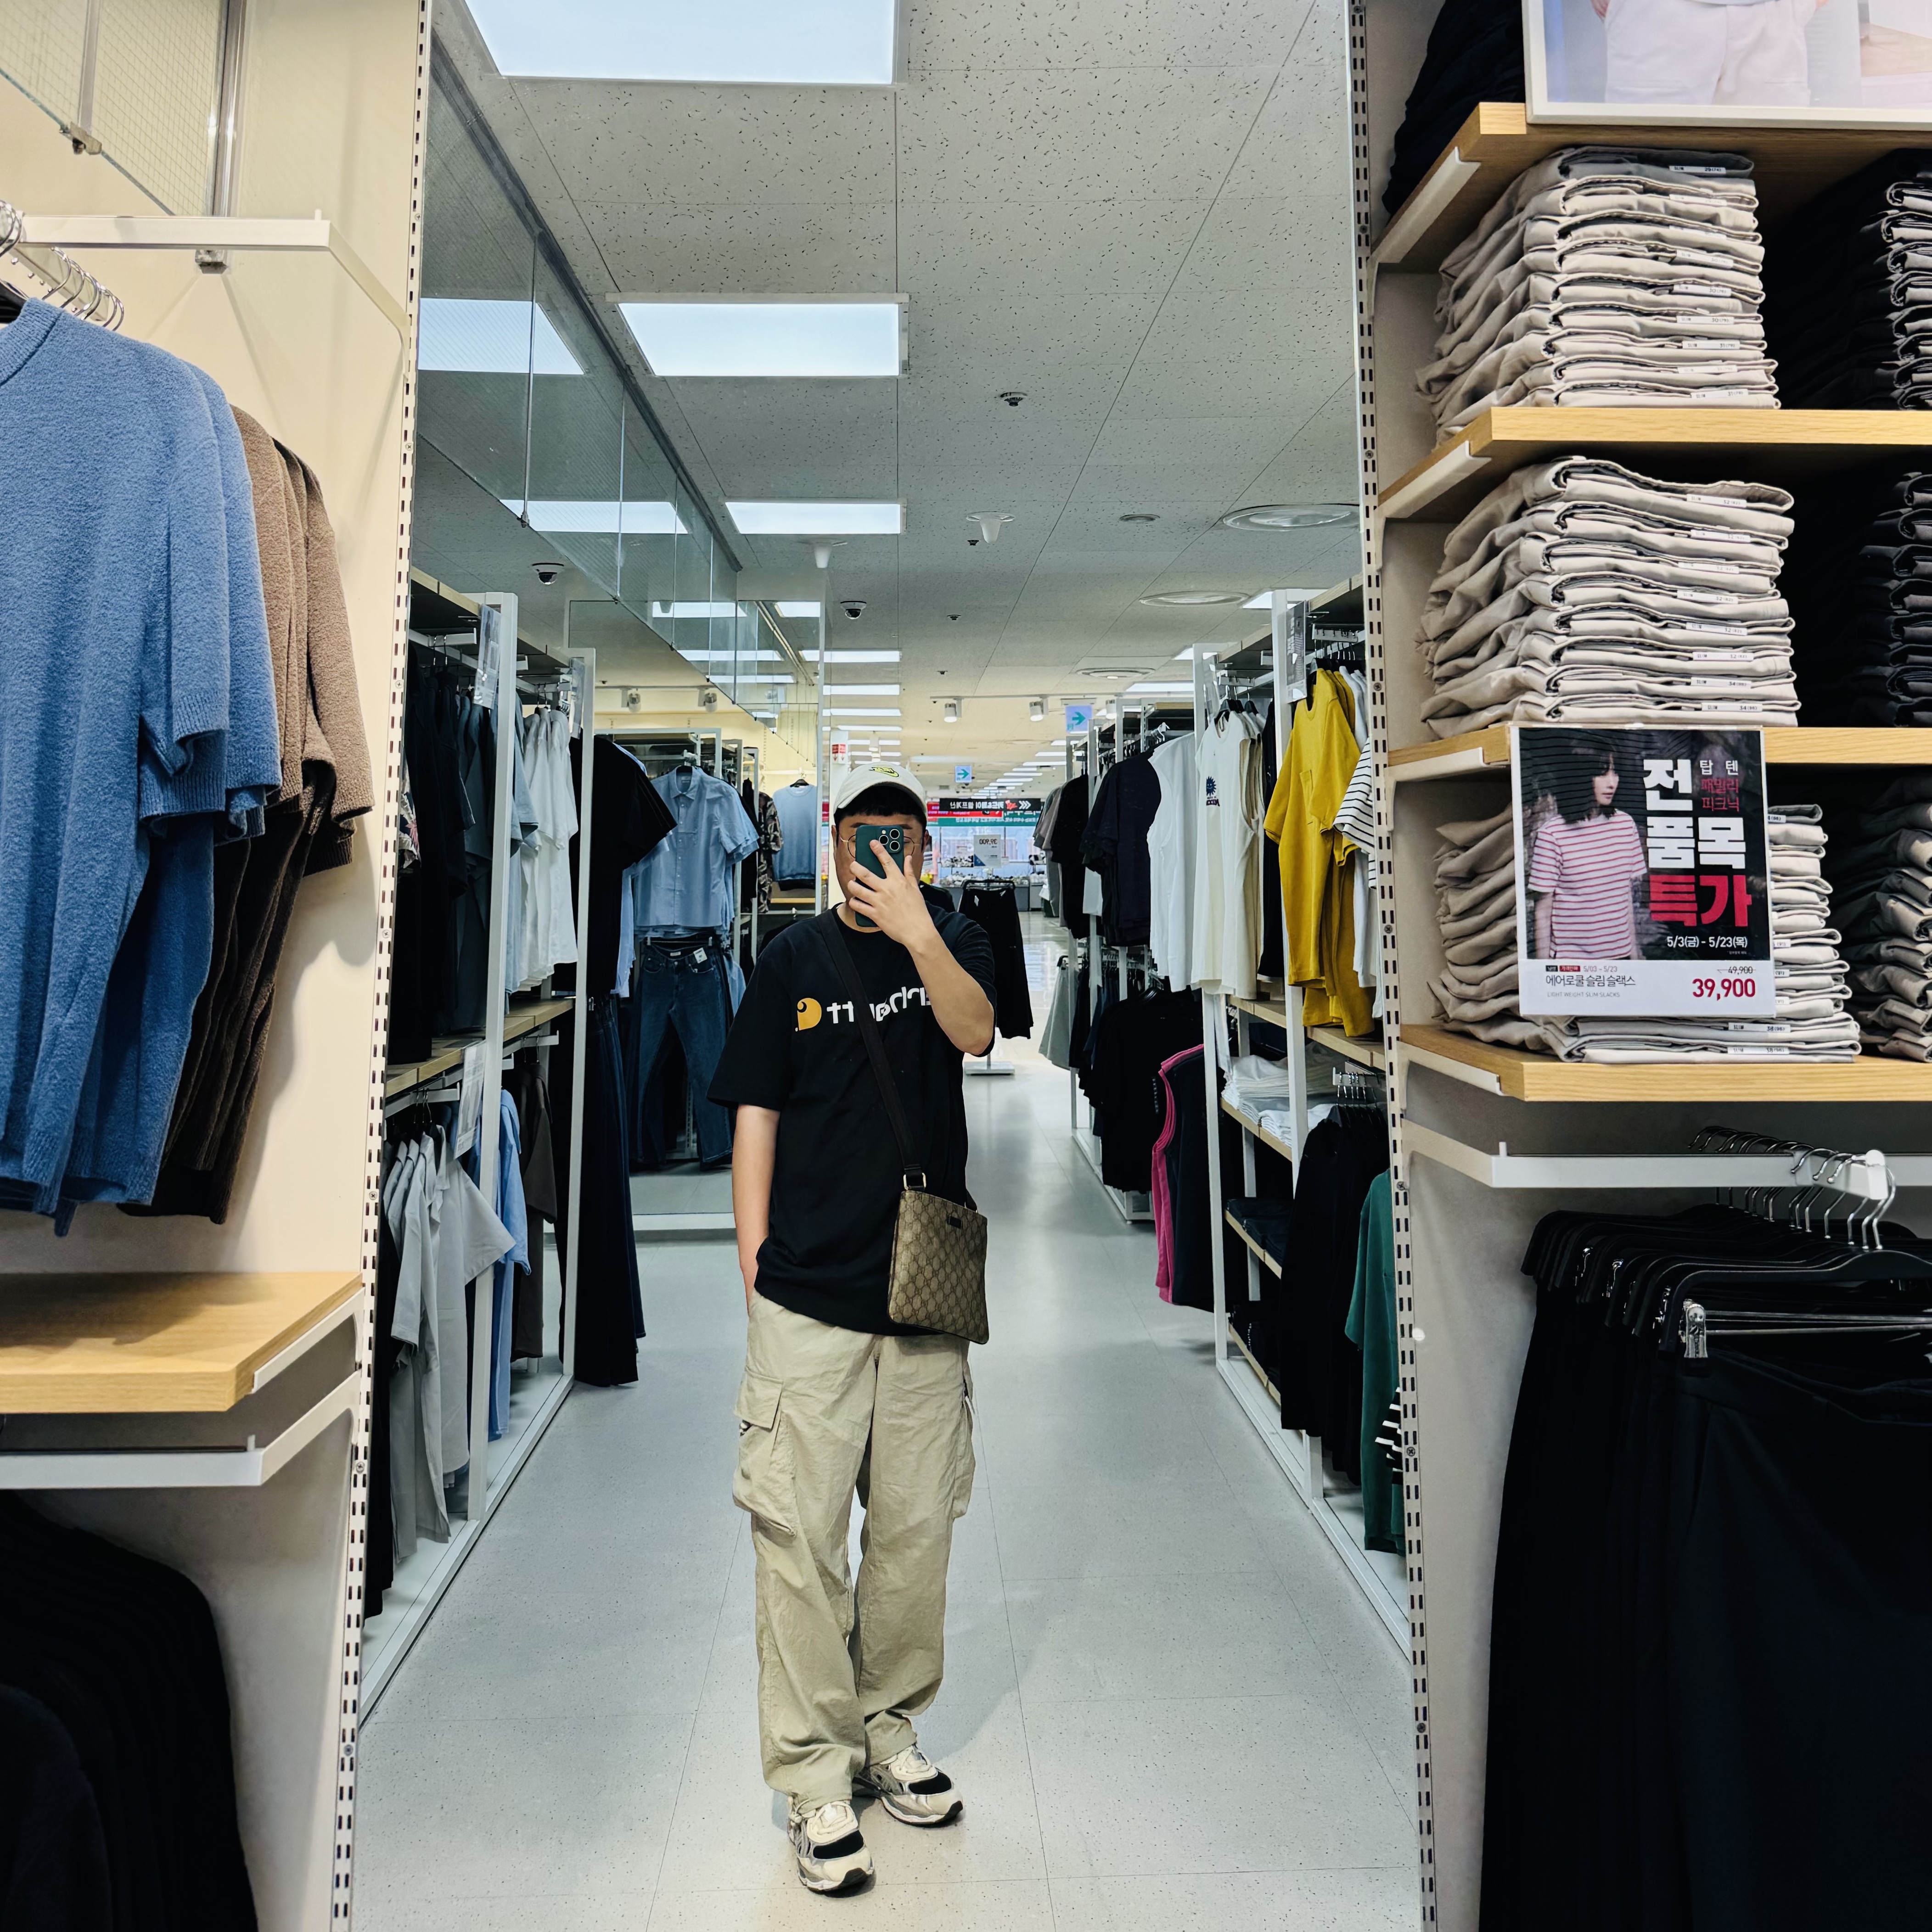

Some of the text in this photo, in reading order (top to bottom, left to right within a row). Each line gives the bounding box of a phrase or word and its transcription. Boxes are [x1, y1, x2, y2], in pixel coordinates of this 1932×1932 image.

[1643, 759, 1693, 811] 전
[1701, 778, 1739, 794] 패밀리
[1701, 796, 1739, 812] 피크닉
[1646, 817, 1746, 869] 품목
[1649, 874, 1752, 927] 특가
[1667, 935, 1700, 948] 5/3(금)
[1708, 935, 1748, 948] 5/23(목)
[1728, 966, 1753, 975] 49,900
[1546, 974, 1636, 987] 에어로쿨 슬림 슬랙스
[1692, 978, 1756, 1001] 39,900
